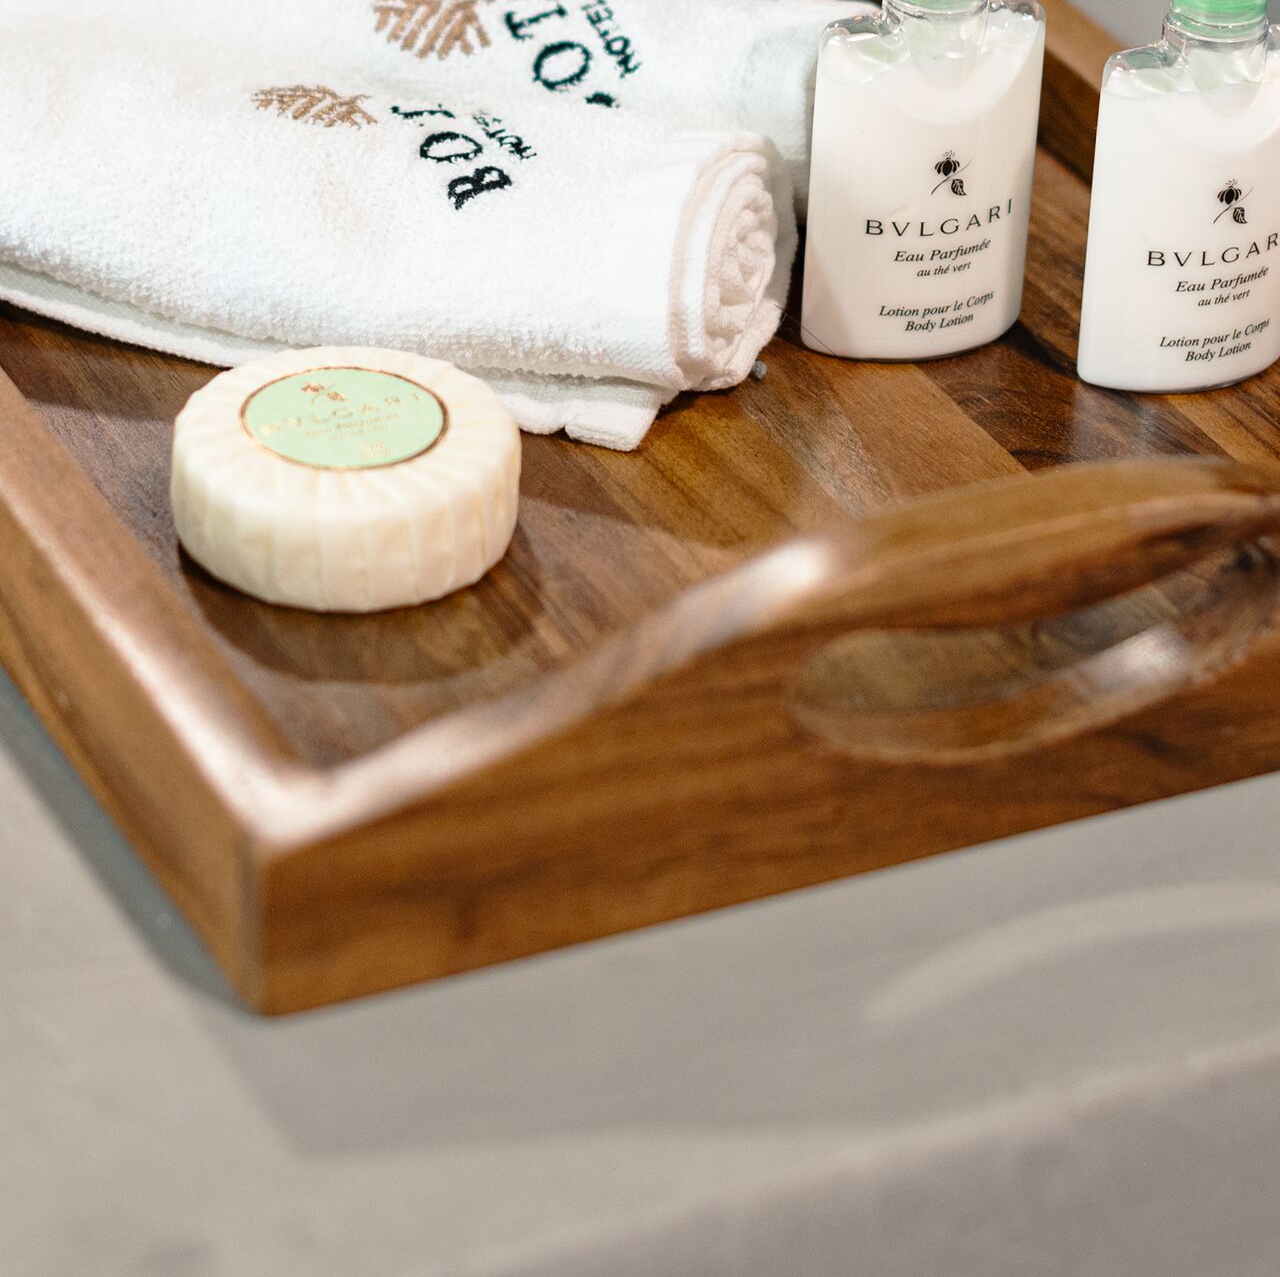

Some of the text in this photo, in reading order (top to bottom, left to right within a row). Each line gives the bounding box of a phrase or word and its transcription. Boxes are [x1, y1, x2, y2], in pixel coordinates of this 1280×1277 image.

[865, 198, 1013, 237] BVLGARI
[894, 238, 991, 262] Eau Parfumée
[916, 269, 931, 277] au
[1176, 265, 1269, 292] Eau Parfumée
[879, 291, 995, 319] Lotion pour le Corps
[1197, 298, 1212, 307] au
[904, 313, 974, 333] Body Lotion
[1159, 318, 1271, 348] Lotion pour le Corps
[1185, 341, 1252, 362] Body Lotion
